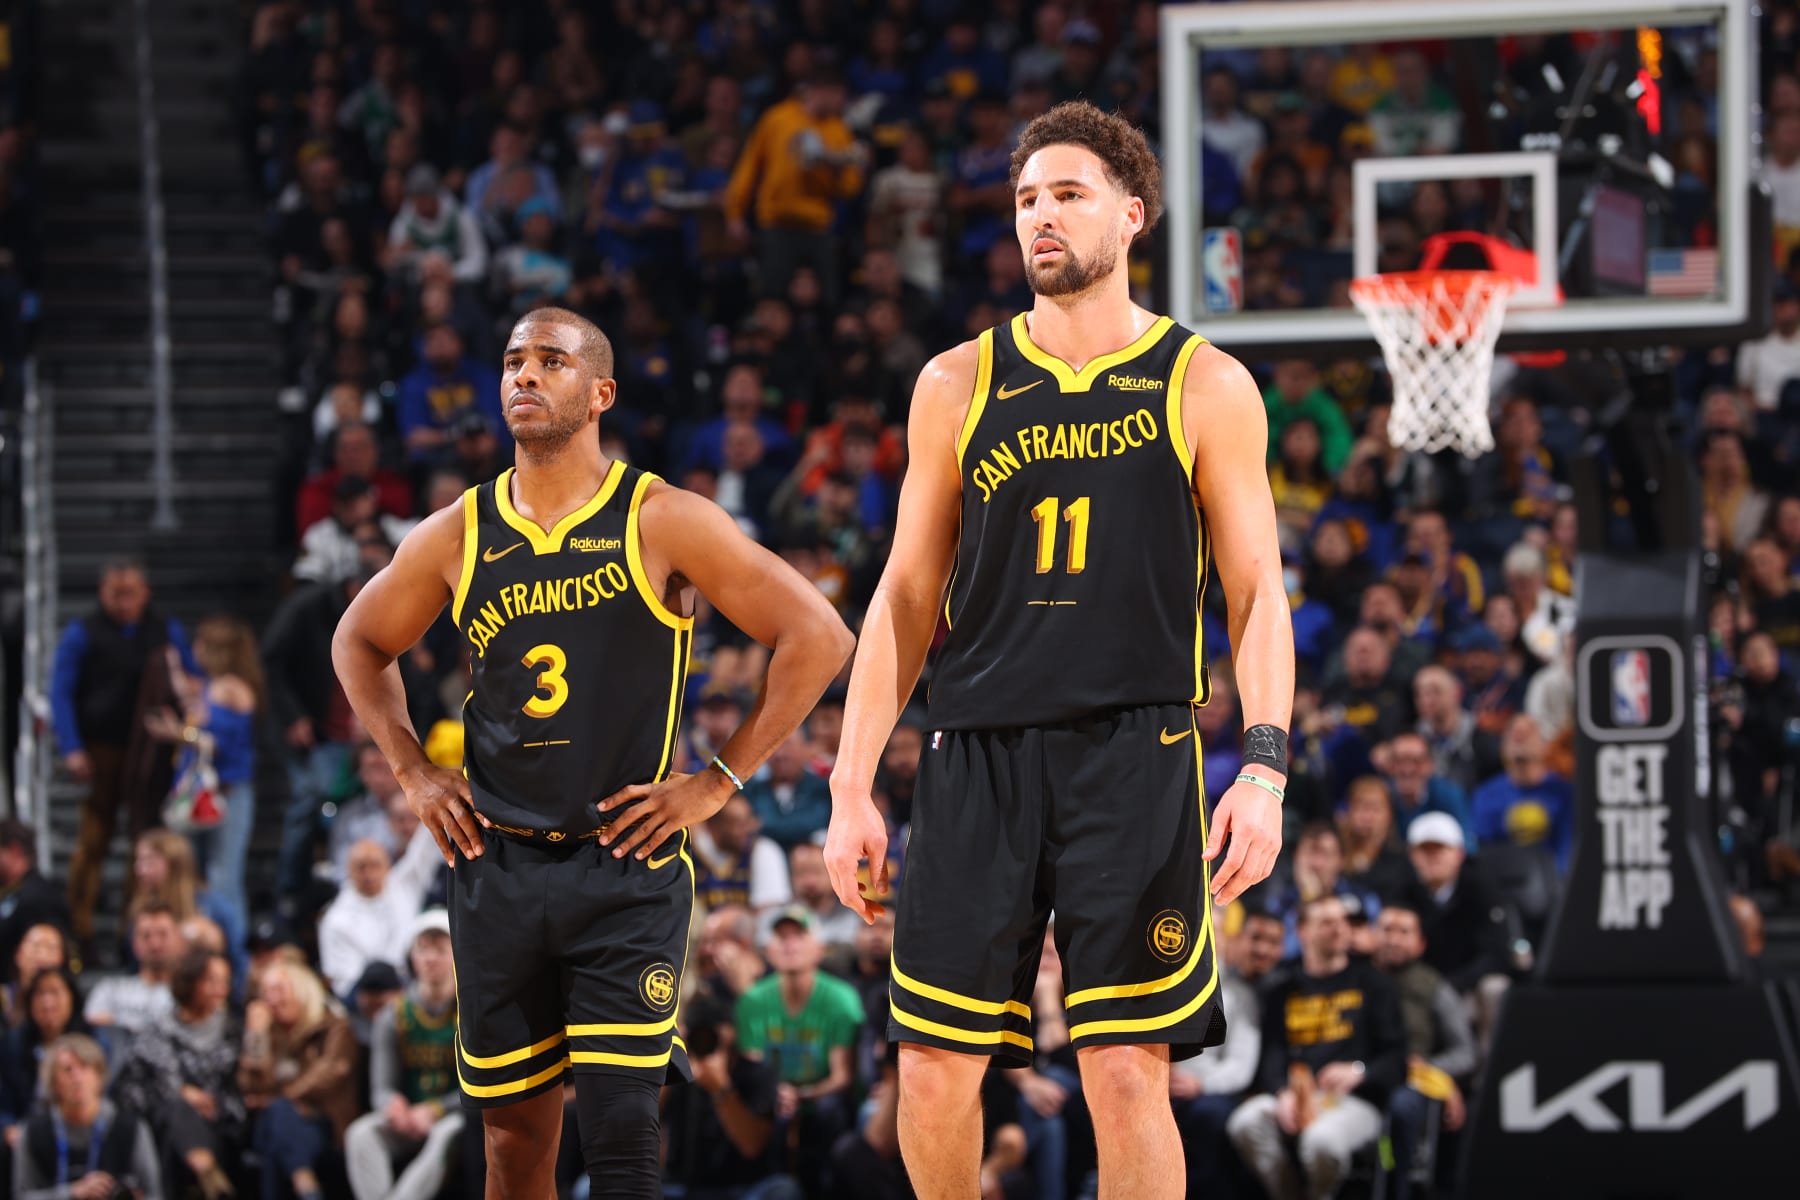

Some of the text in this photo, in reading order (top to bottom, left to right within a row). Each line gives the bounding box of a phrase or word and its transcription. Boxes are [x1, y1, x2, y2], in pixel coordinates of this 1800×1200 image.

[1107, 374, 1164, 390] Rakuten
[972, 408, 1158, 502] SAN FRANCISCO
[569, 537, 622, 551] Rakuten
[1030, 496, 1091, 575] 11
[467, 561, 628, 658] SAN FRANCISCO
[521, 643, 569, 719] 3
[1597, 743, 1668, 803] GET
[1596, 805, 1671, 866] THE
[1599, 868, 1673, 929] APP
